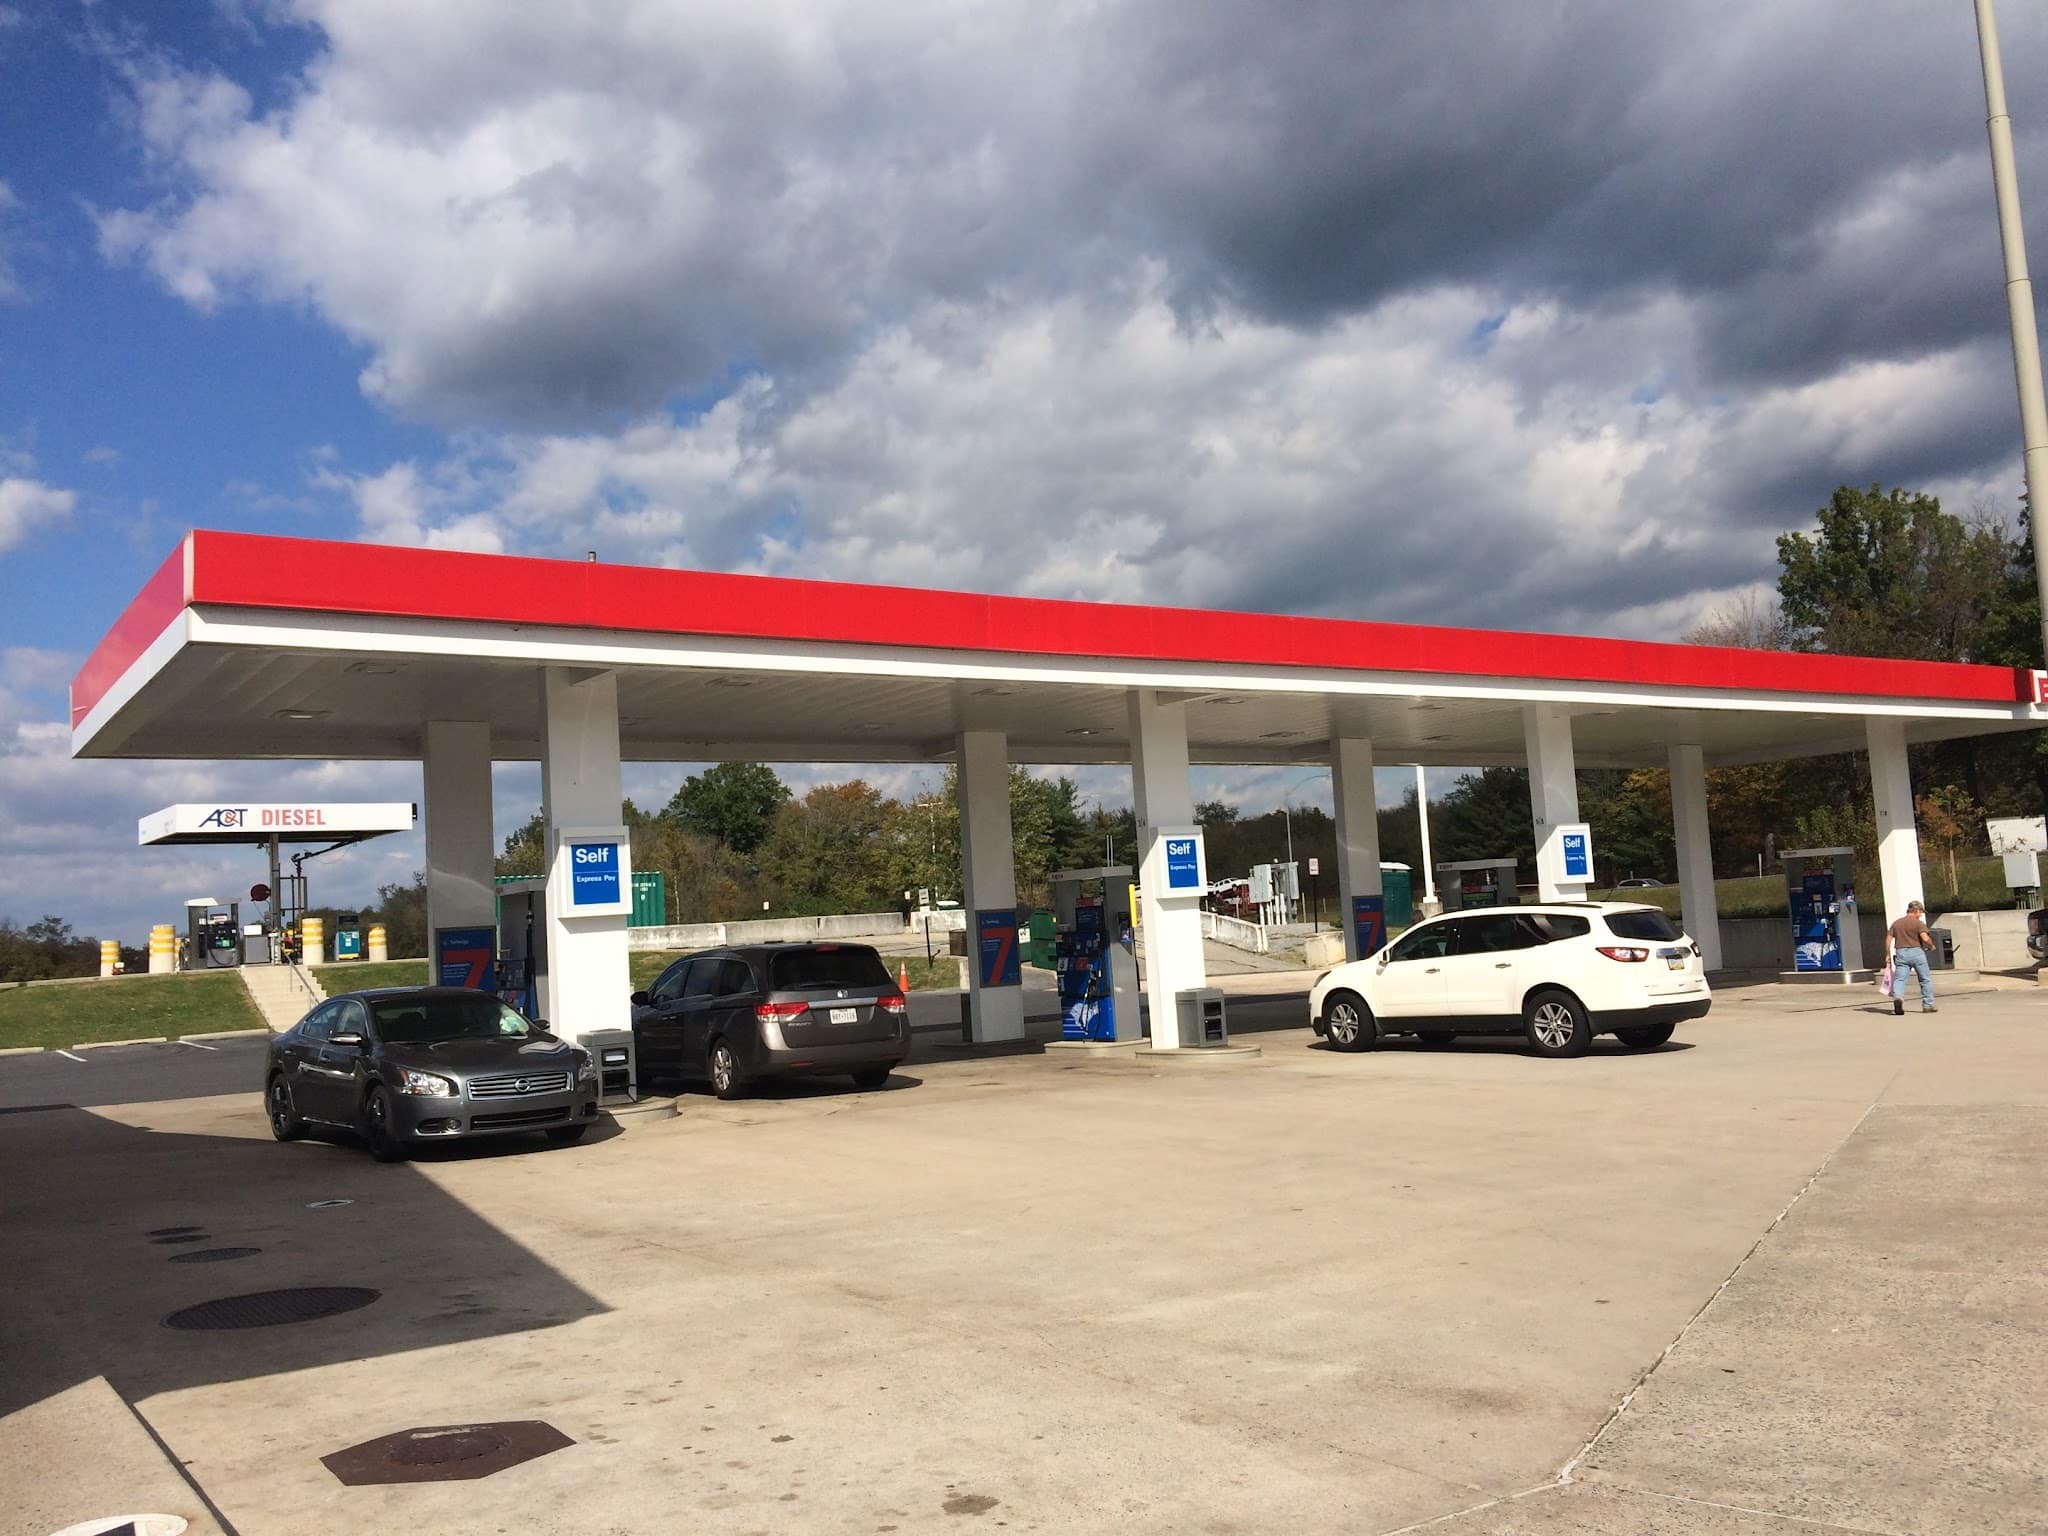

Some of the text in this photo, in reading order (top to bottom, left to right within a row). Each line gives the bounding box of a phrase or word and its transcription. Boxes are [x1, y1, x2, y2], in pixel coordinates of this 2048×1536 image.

[262, 809, 326, 825] DIESEL
[1169, 843, 1191, 856] Self
[1565, 837, 1580, 848] Self
[575, 848, 609, 863] Self
[576, 874, 616, 883] Express Pay
[982, 928, 1014, 984] 7
